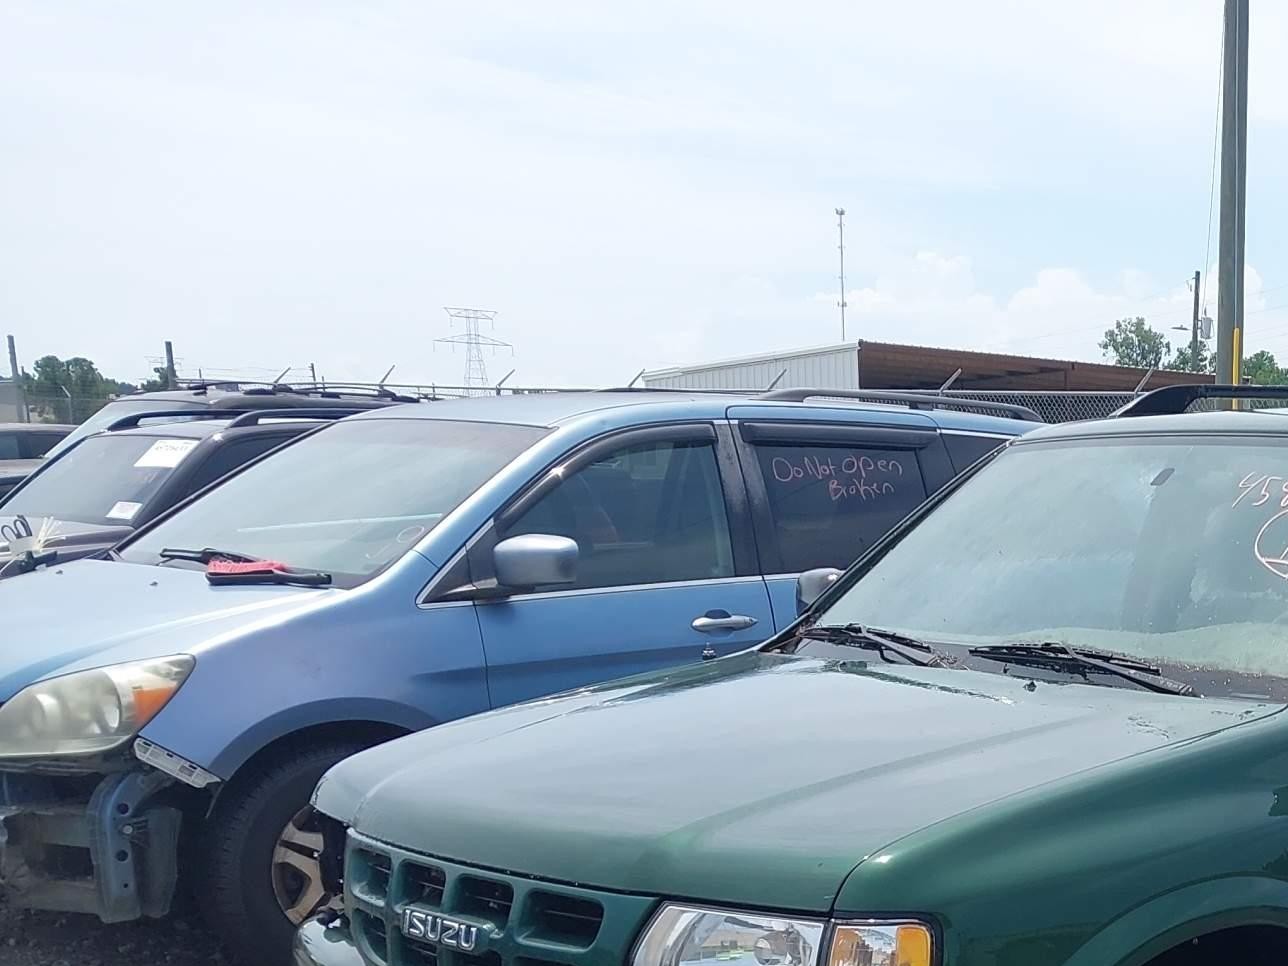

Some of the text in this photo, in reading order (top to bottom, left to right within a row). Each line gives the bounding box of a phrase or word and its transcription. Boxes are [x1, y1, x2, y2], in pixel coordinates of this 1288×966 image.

[772, 457, 804, 482] Do
[804, 455, 837, 479] Not
[828, 479, 895, 501] Broken
[403, 909, 478, 951] ISUZU
